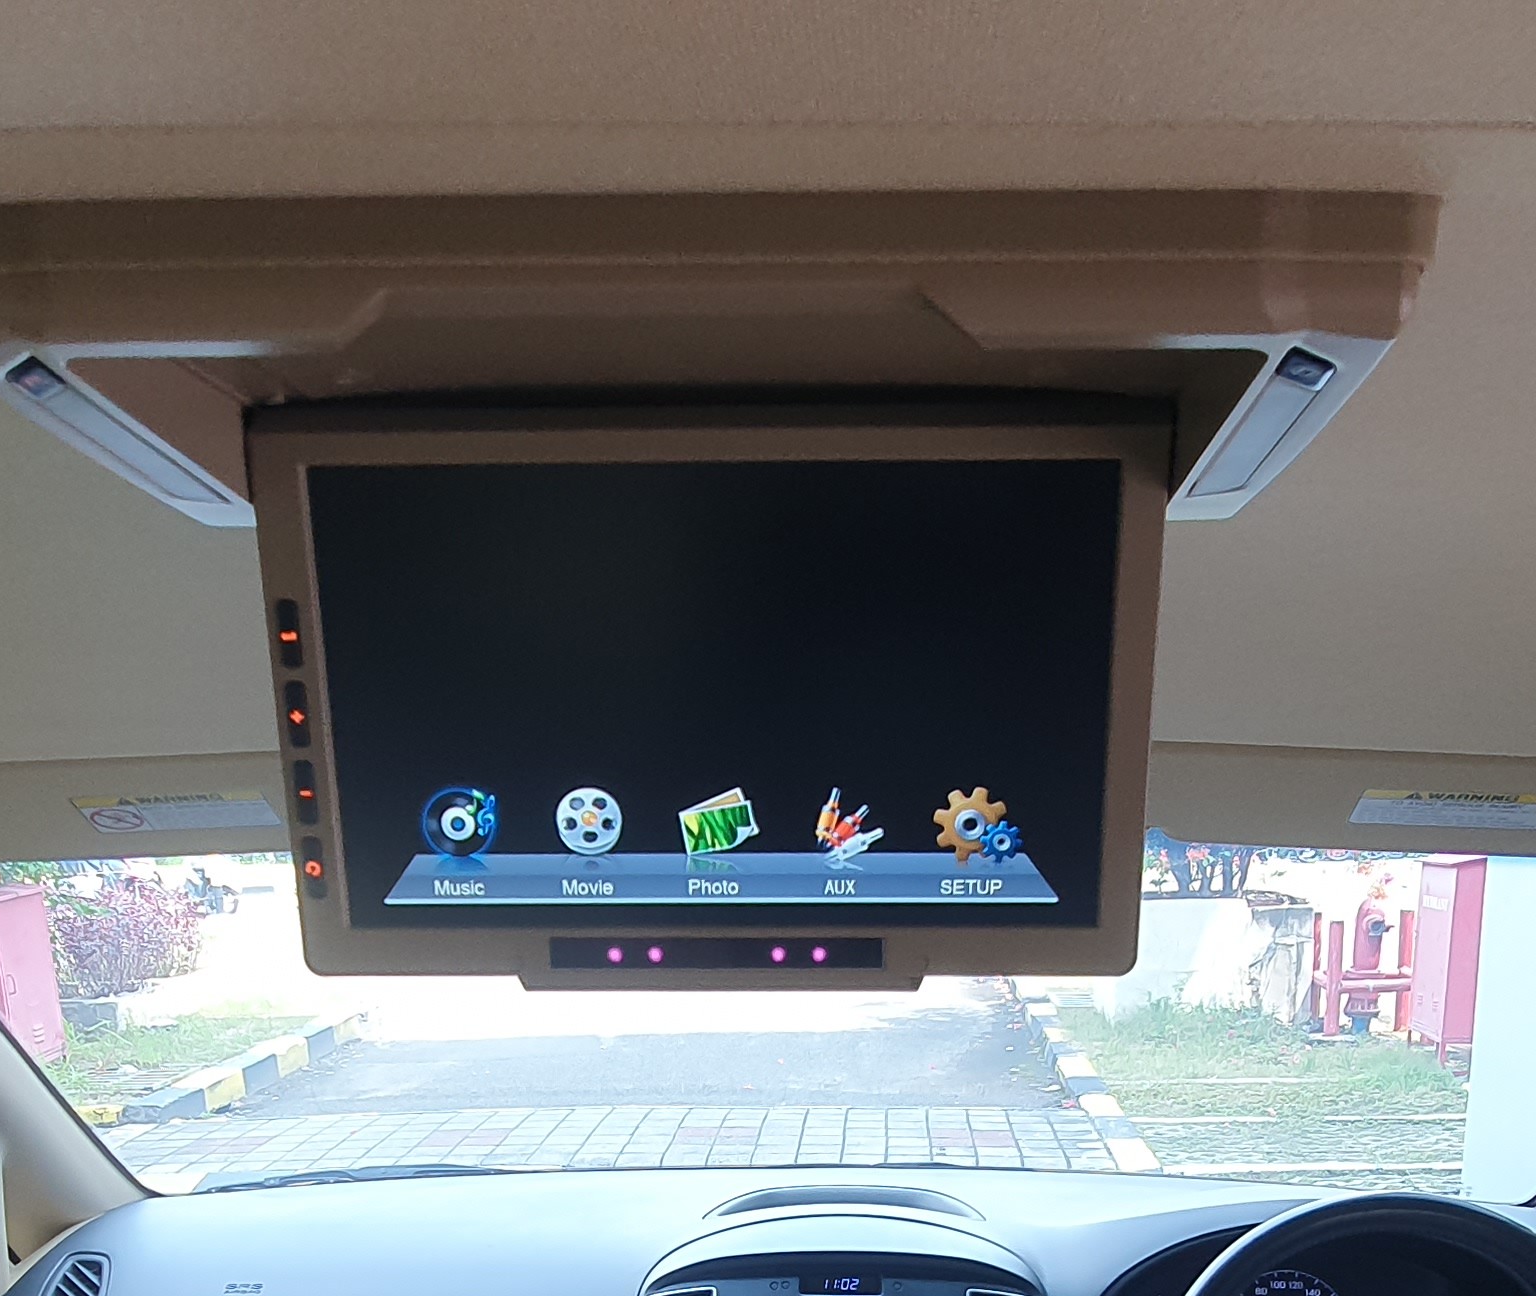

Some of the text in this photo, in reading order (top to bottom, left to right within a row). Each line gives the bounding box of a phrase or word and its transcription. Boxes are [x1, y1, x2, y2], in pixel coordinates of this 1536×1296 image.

[1428, 792, 1520, 803] WARNING
[433, 879, 485, 896] Music
[561, 879, 614, 896] Movie
[688, 879, 739, 896] Photo
[824, 879, 856, 895] AUX
[939, 879, 1003, 895] SETUP
[824, 1278, 860, 1291] 11:02
[1270, 1280, 1286, 1289] 100
[1288, 1280, 1304, 1290] 120
[1255, 1287, 1268, 1296] 80
[1305, 1288, 1321, 1296] 140
